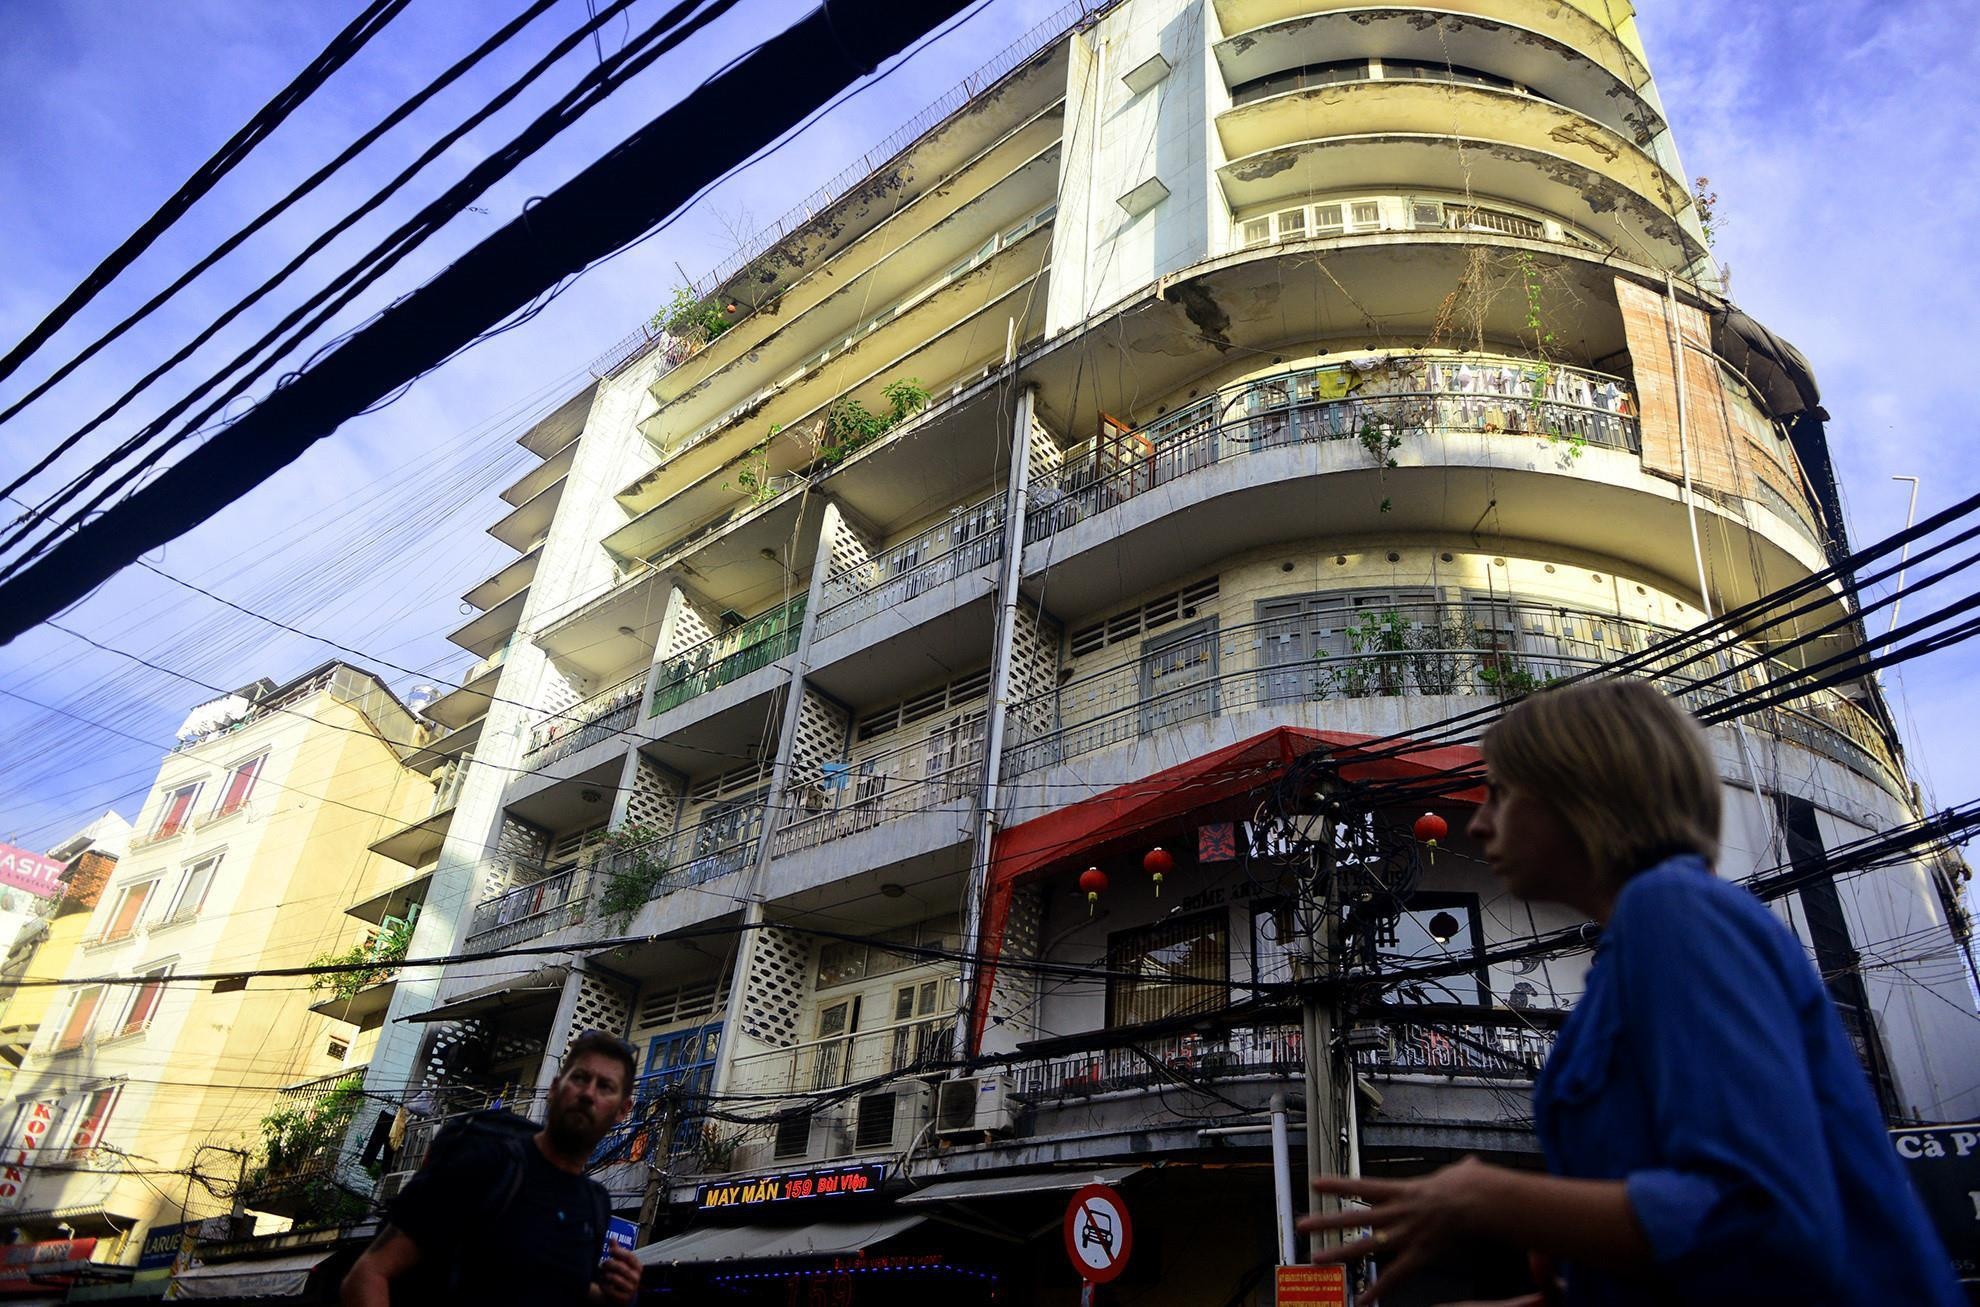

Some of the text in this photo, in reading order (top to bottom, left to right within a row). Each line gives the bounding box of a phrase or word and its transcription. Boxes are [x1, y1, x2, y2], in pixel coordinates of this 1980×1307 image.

[1895, 1131, 1980, 1159] Cà P
[706, 1186, 740, 1207] MAY
[785, 1178, 814, 1200] 159
[144, 1233, 181, 1255] LARUE
